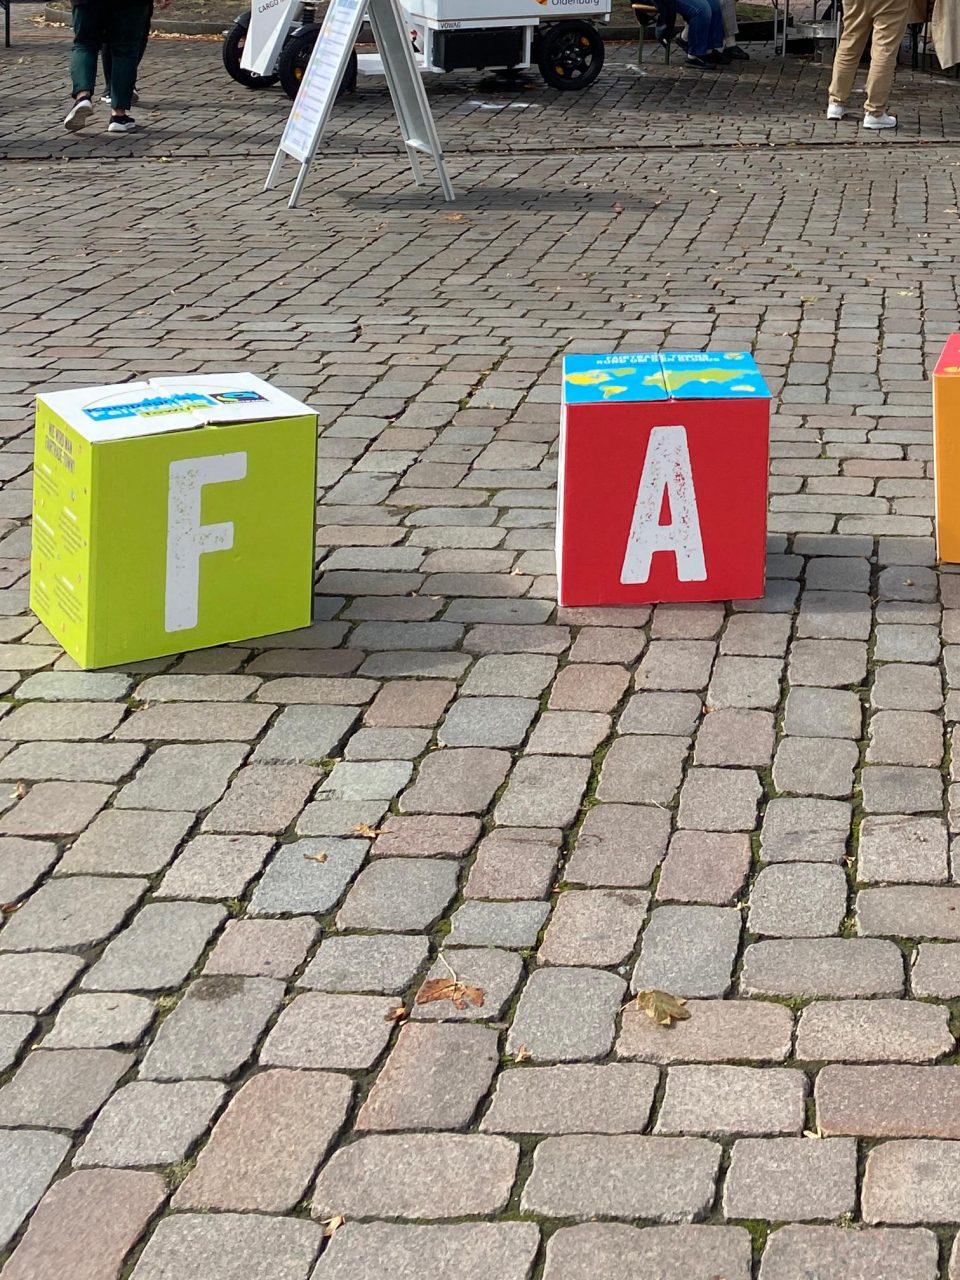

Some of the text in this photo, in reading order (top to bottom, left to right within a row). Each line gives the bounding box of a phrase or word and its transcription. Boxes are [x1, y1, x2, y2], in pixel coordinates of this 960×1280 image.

[258, 0, 279, 14] CARGO
[165, 451, 247, 633] F
[620, 425, 707, 585] A
